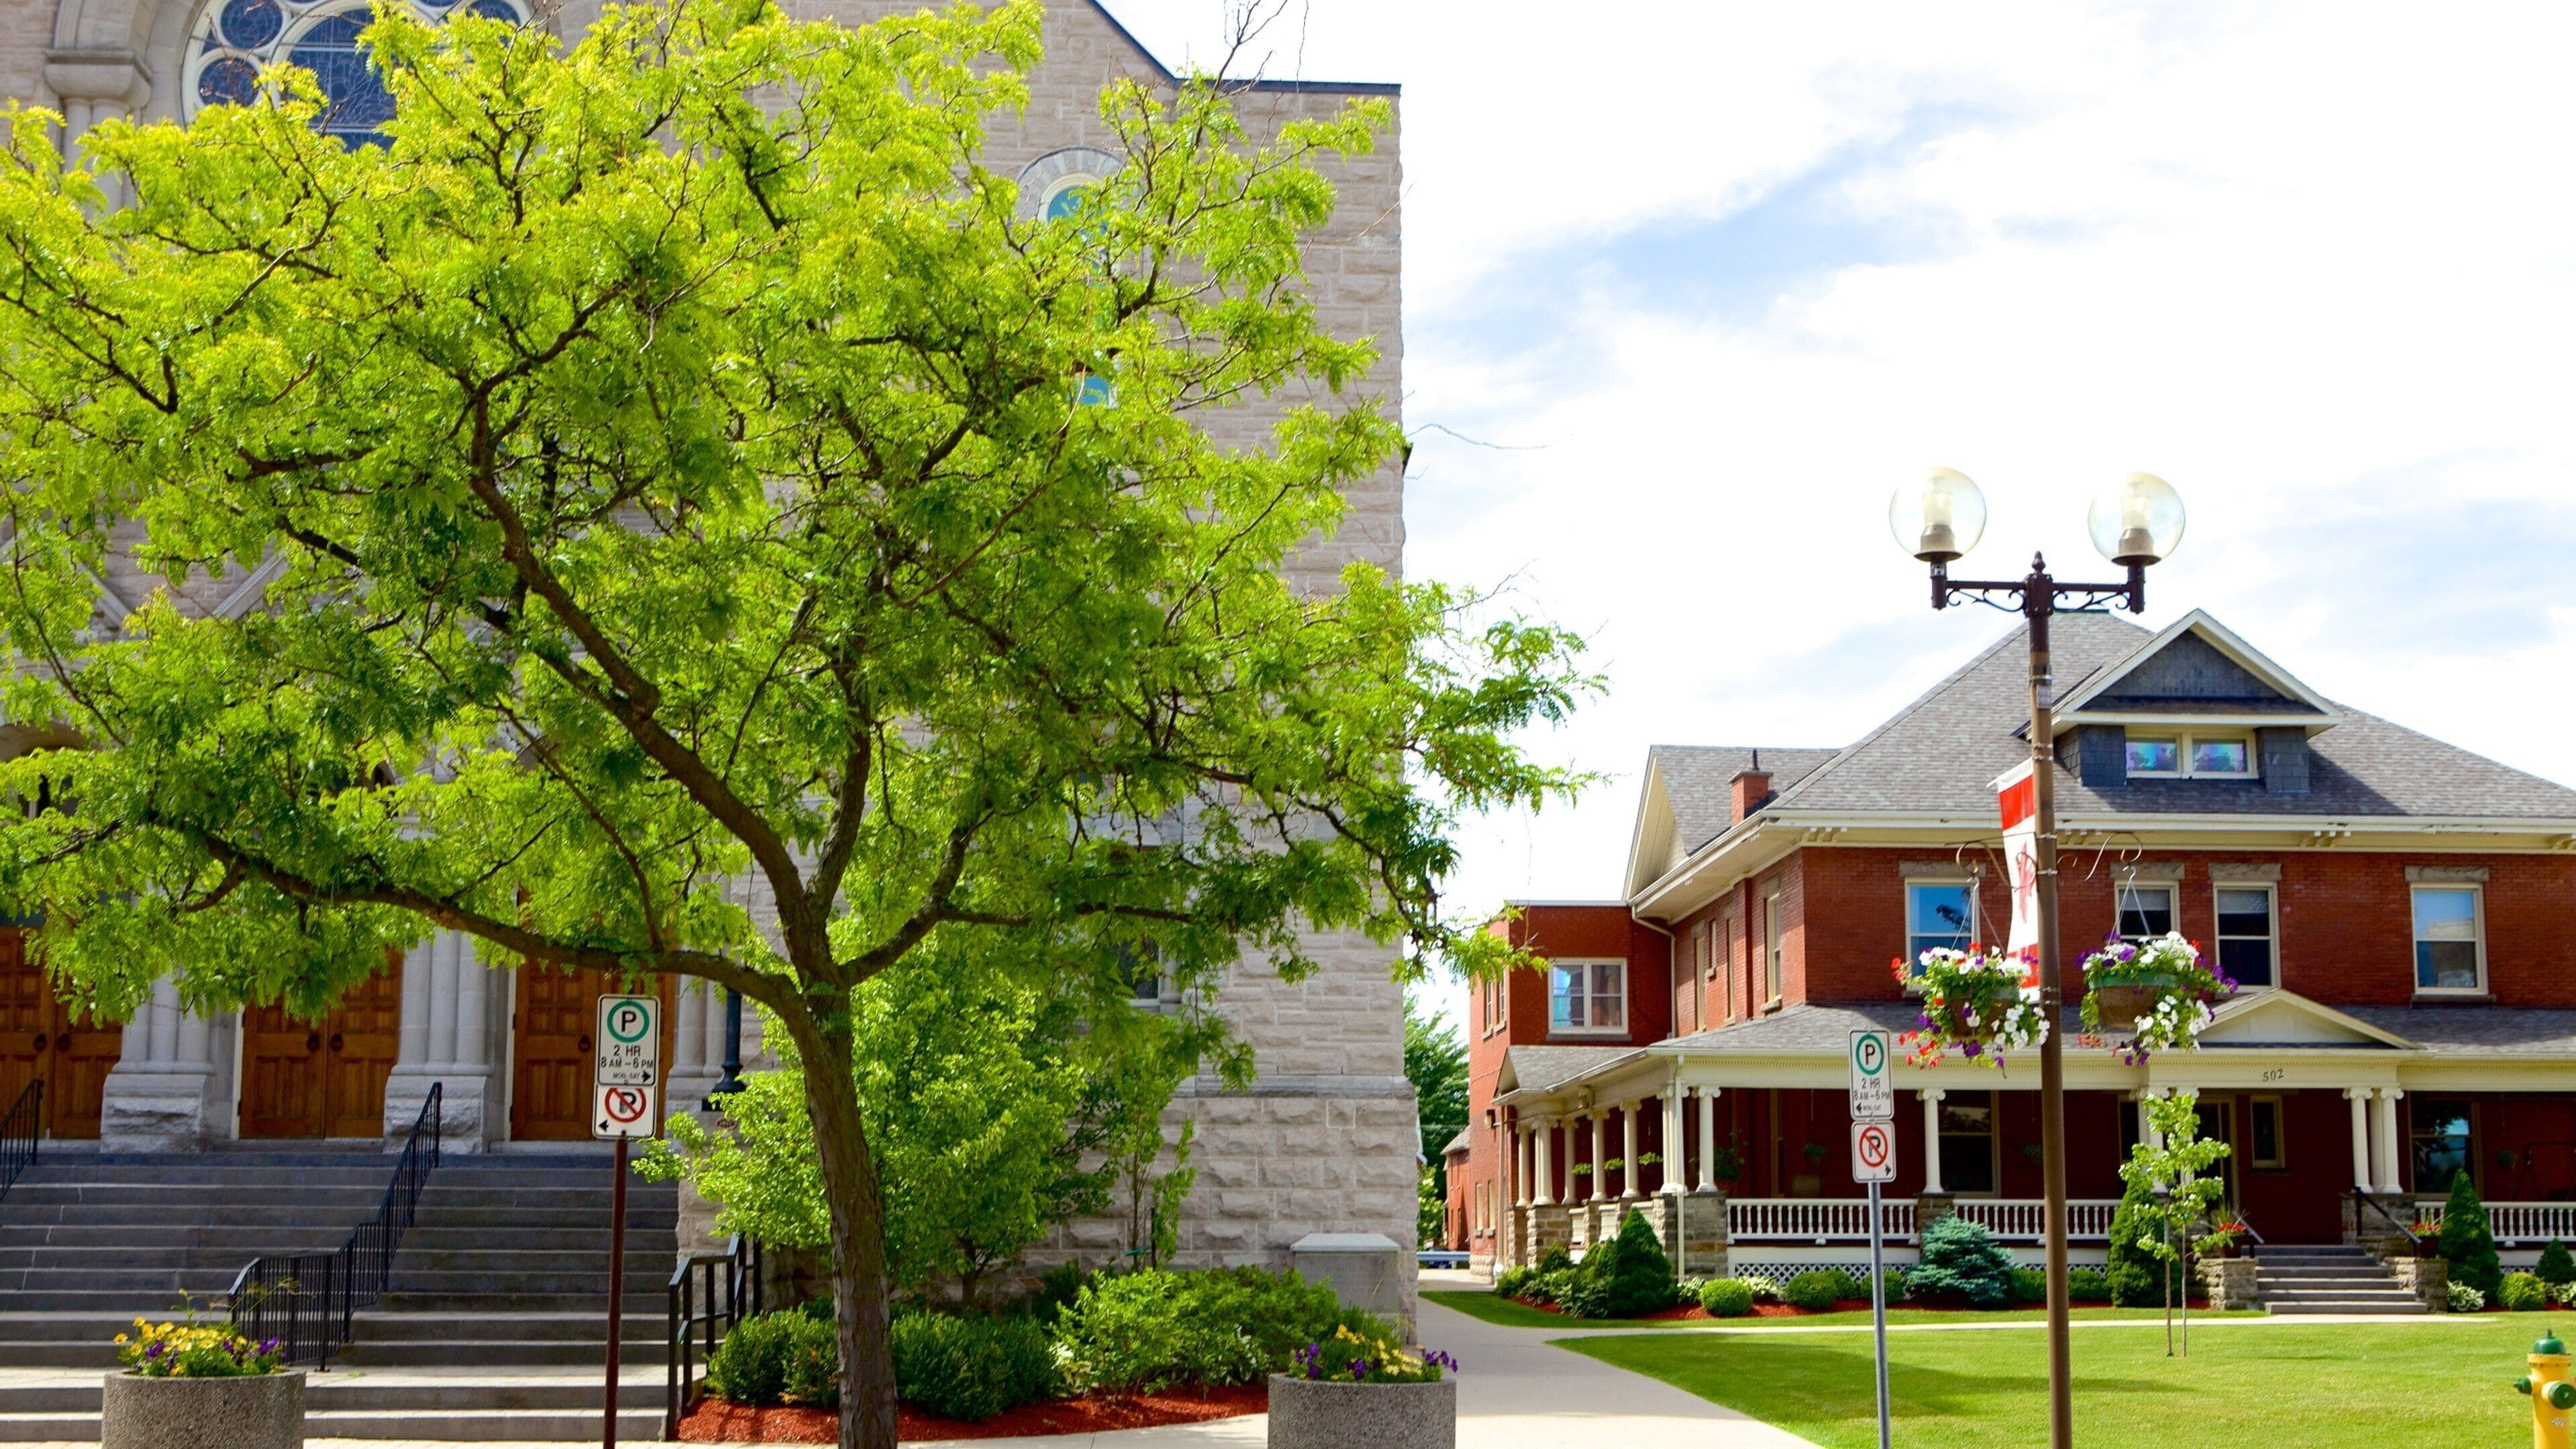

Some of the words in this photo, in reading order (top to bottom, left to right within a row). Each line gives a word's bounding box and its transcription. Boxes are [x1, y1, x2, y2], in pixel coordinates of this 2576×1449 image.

[621, 1010, 637, 1032] P
[613, 1044, 620, 1057] 2
[626, 1045, 641, 1057] HR
[1865, 1044, 1876, 1065] P
[601, 1057, 607, 1068] 8
[609, 1059, 622, 1068] AM
[633, 1057, 639, 1068] 6
[641, 1060, 653, 1069] PM
[2262, 1068, 2284, 1082] 502
[1862, 1077, 1867, 1089] 2
[1870, 1078, 1880, 1089] HR
[1854, 1090, 1858, 1100] 8
[1860, 1091, 1868, 1100] AM
[1881, 1091, 1890, 1100] PM
